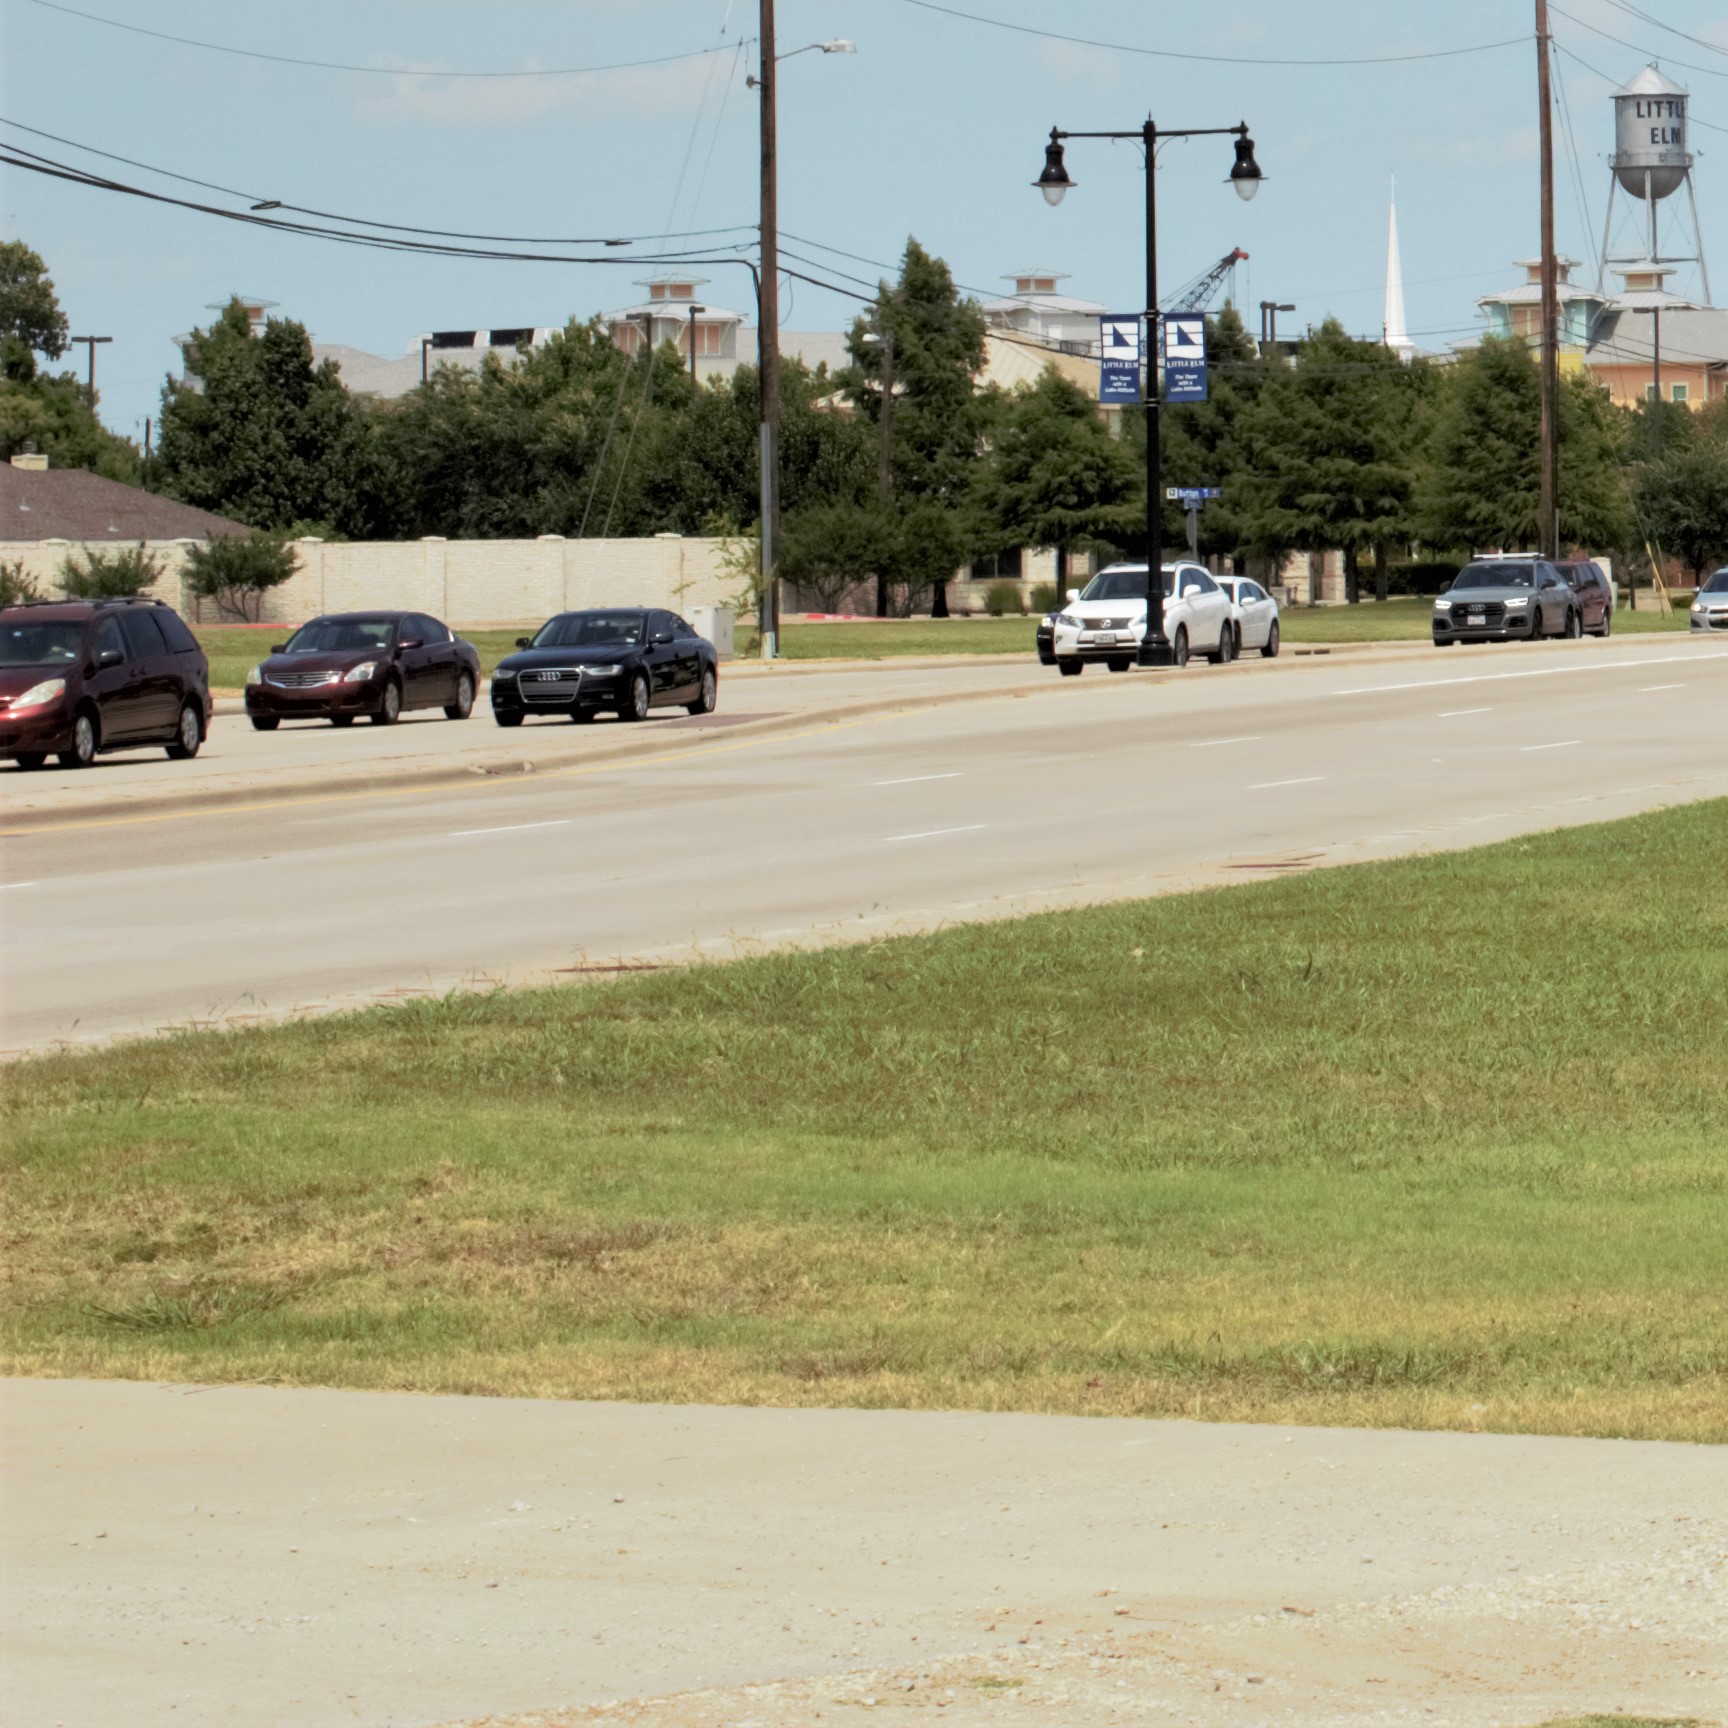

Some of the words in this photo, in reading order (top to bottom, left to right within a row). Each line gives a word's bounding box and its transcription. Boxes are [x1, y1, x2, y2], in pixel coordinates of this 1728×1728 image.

[1650, 127, 1681, 145] ELM
[1103, 361, 1123, 369] LITTLE
[1125, 361, 1139, 369] ELM
[1166, 360, 1189, 369] LITTLE
[1190, 360, 1205, 368] ELM
